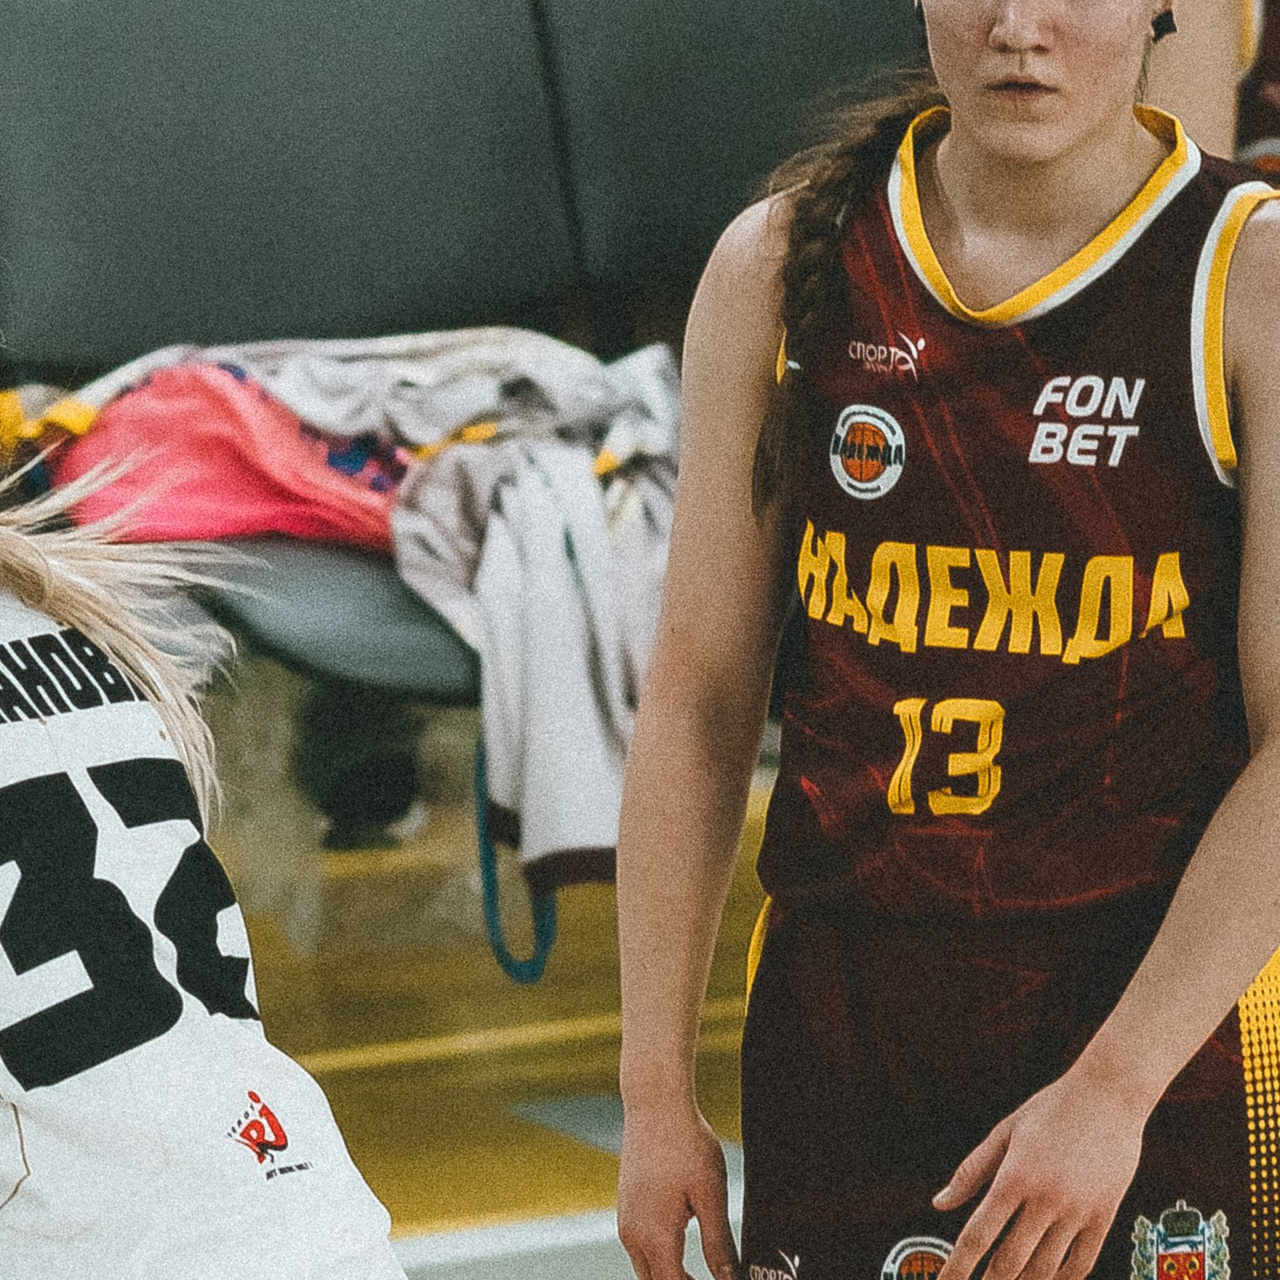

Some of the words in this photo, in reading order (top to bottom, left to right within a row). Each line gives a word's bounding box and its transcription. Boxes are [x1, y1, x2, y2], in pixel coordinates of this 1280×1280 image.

[1033, 375, 1146, 418] FON
[1028, 422, 1139, 467] BET
[797, 518, 1190, 665] НАДЕЖДА
[887, 698, 1006, 815] 13
